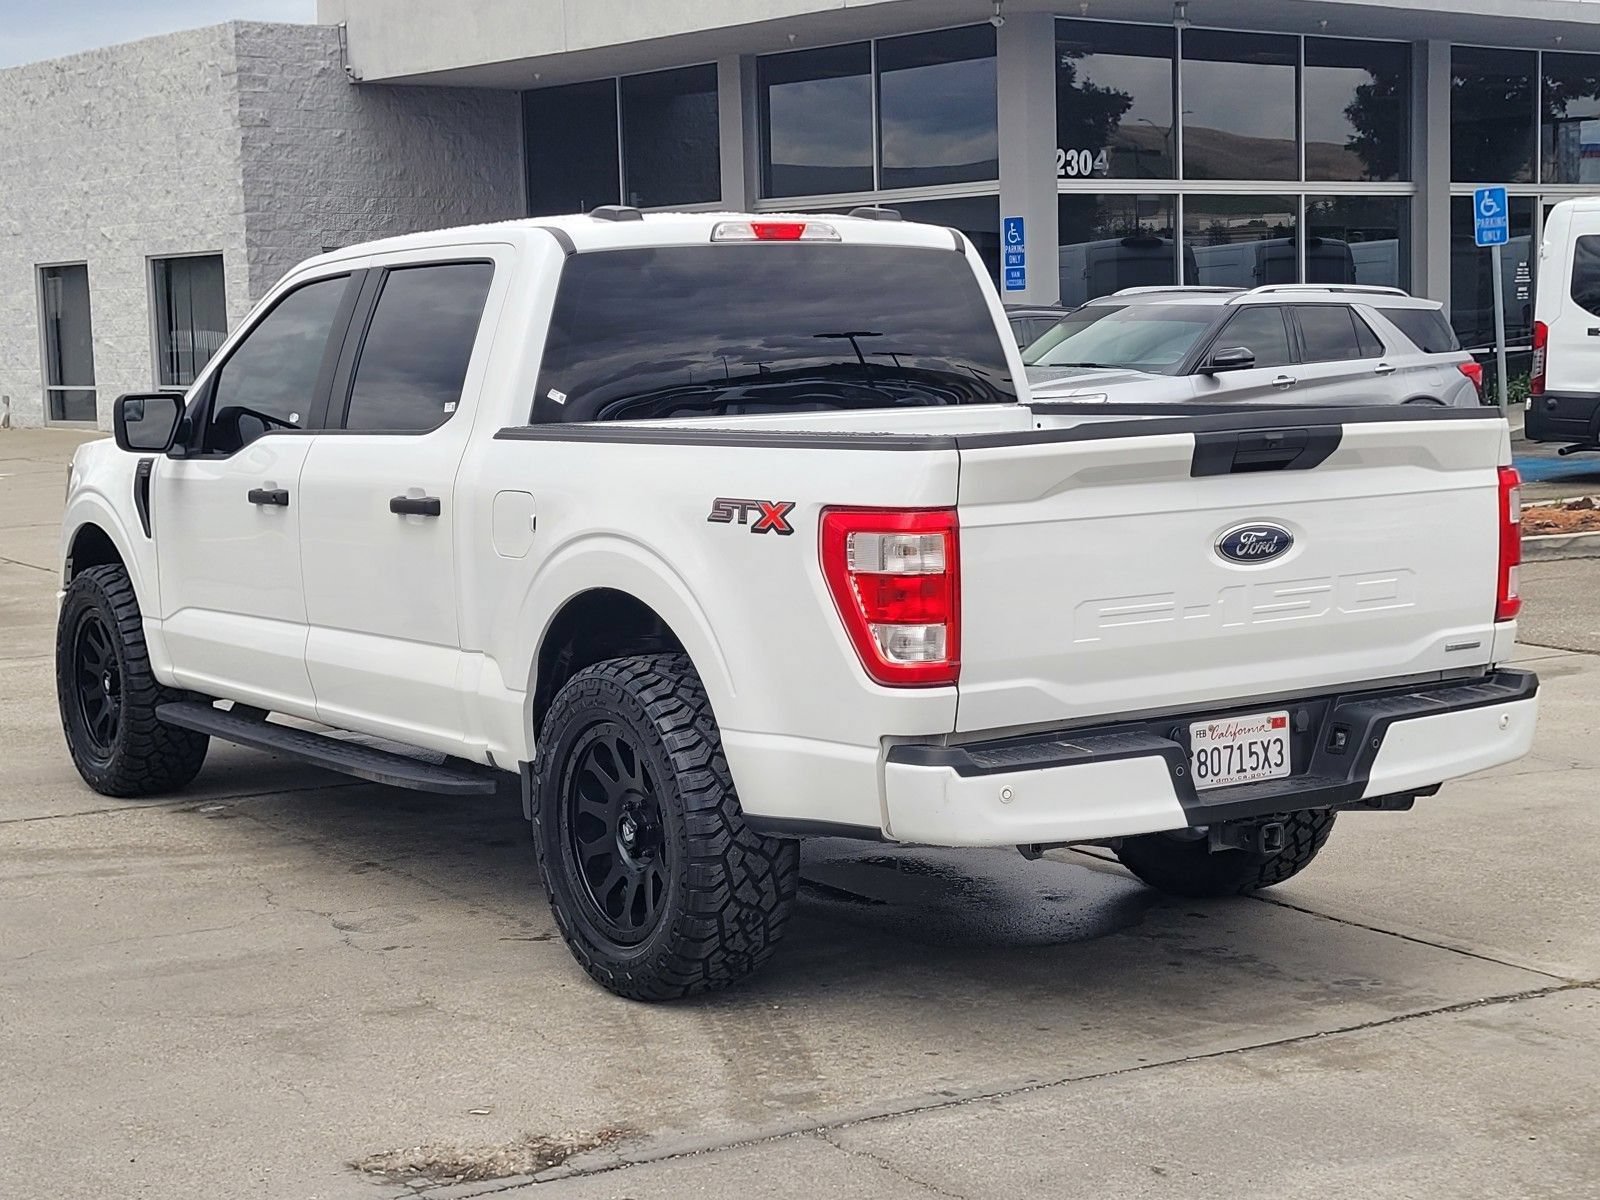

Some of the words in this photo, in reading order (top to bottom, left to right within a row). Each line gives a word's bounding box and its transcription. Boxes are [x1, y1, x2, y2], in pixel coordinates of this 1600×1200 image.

[1056, 148, 1109, 176] 2304
[1005, 244, 1025, 254] PARKING
[1009, 255, 1021, 264] ONLY
[707, 497, 796, 536] STX
[1236, 531, 1278, 555] Ford
[1073, 568, 1416, 643] F-150
[1195, 729, 1207, 739] FEB
[1210, 722, 1269, 741] California
[1196, 738, 1285, 778] 80715X3
[1216, 771, 1266, 784] dmv.ca.gov
